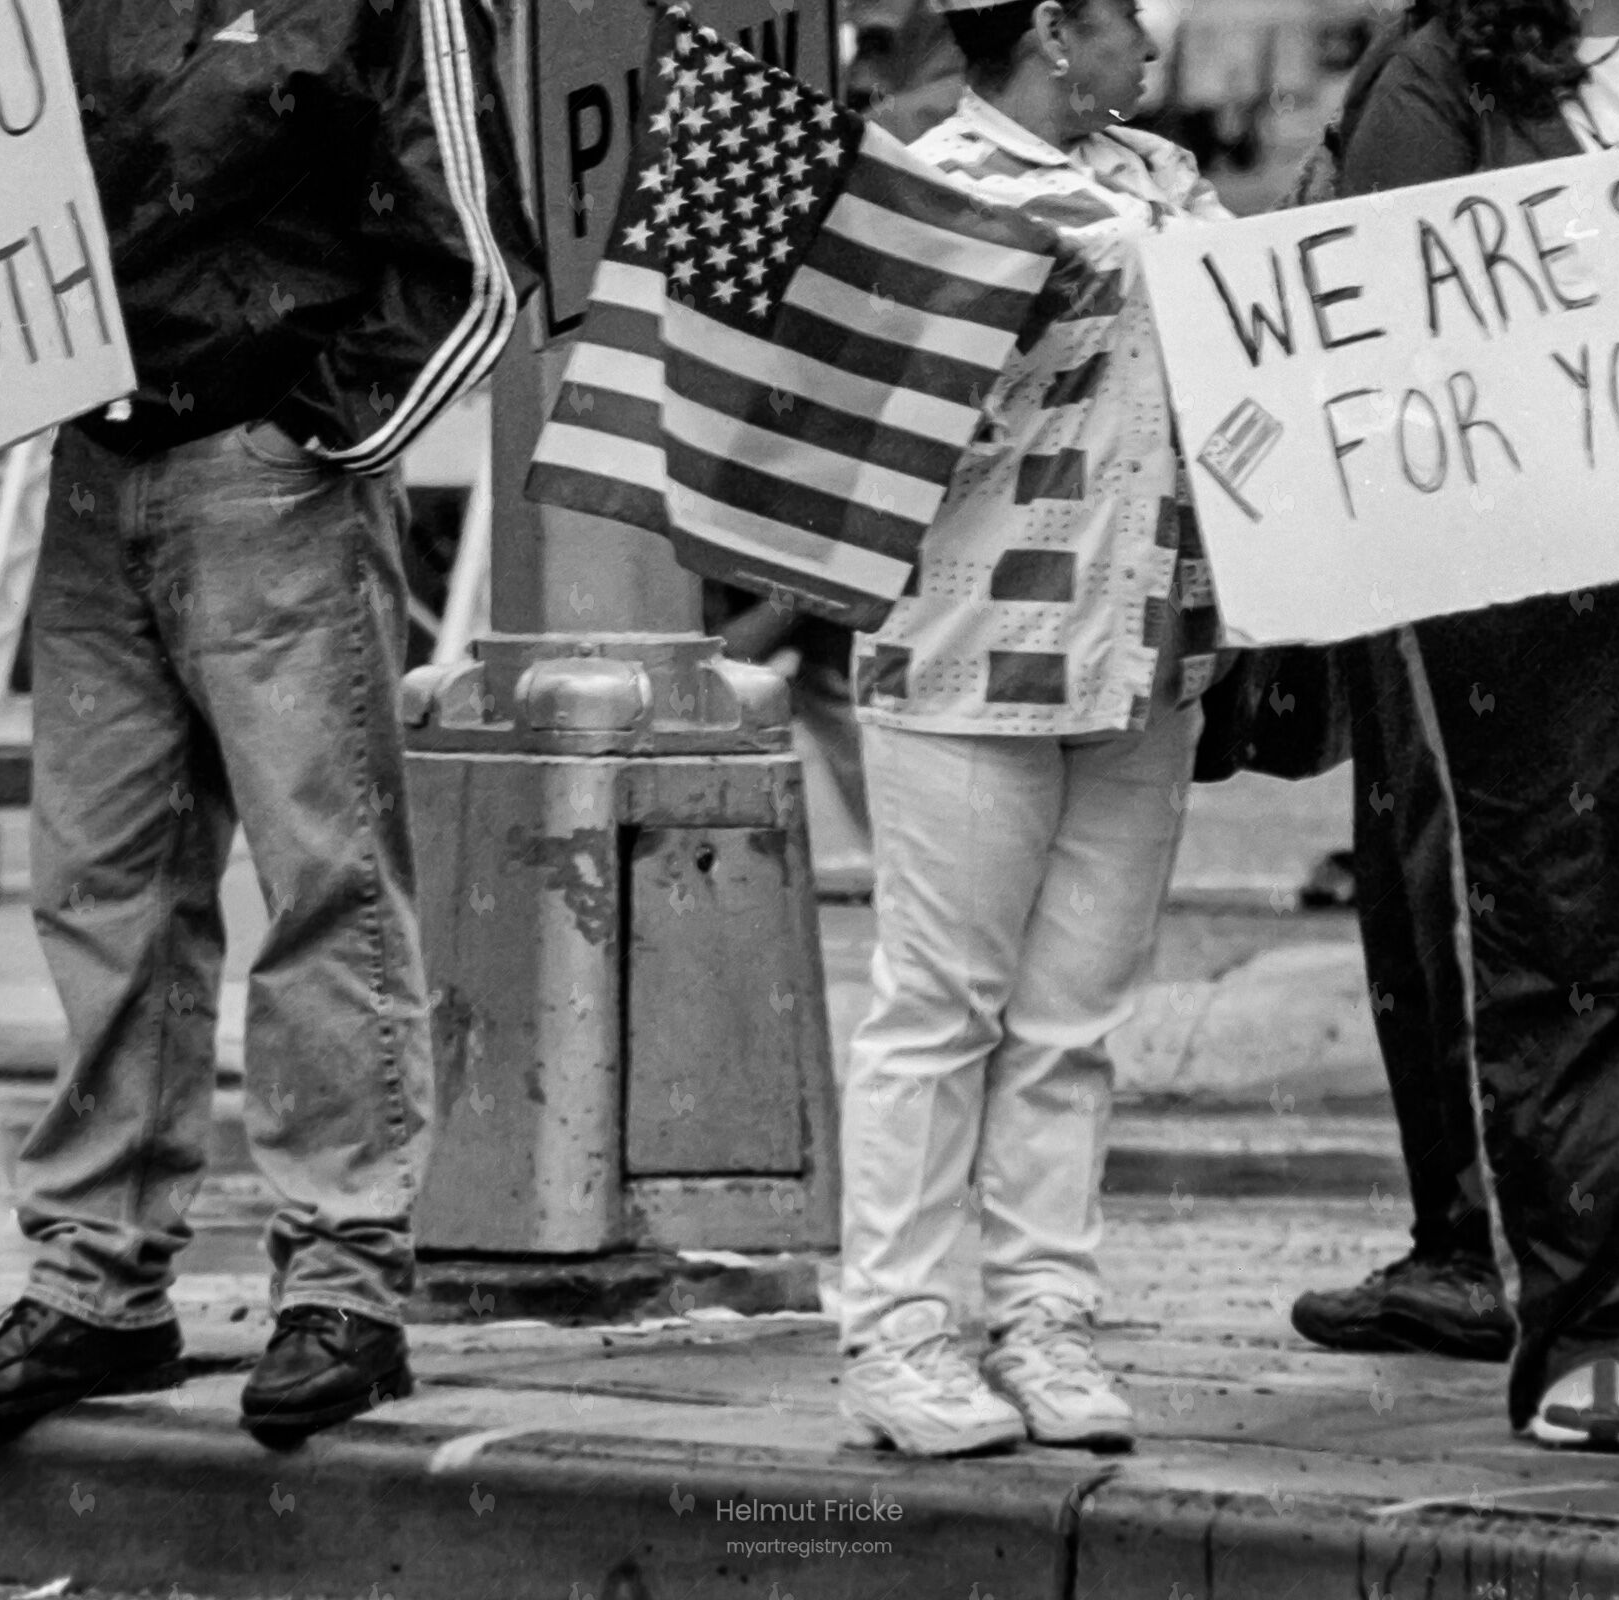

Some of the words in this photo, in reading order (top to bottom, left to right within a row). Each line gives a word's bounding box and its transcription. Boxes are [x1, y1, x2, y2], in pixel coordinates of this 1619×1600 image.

[1200, 224, 1386, 368] WE
[1415, 183, 1602, 340] ARE
[1322, 369, 1524, 521] FOR
